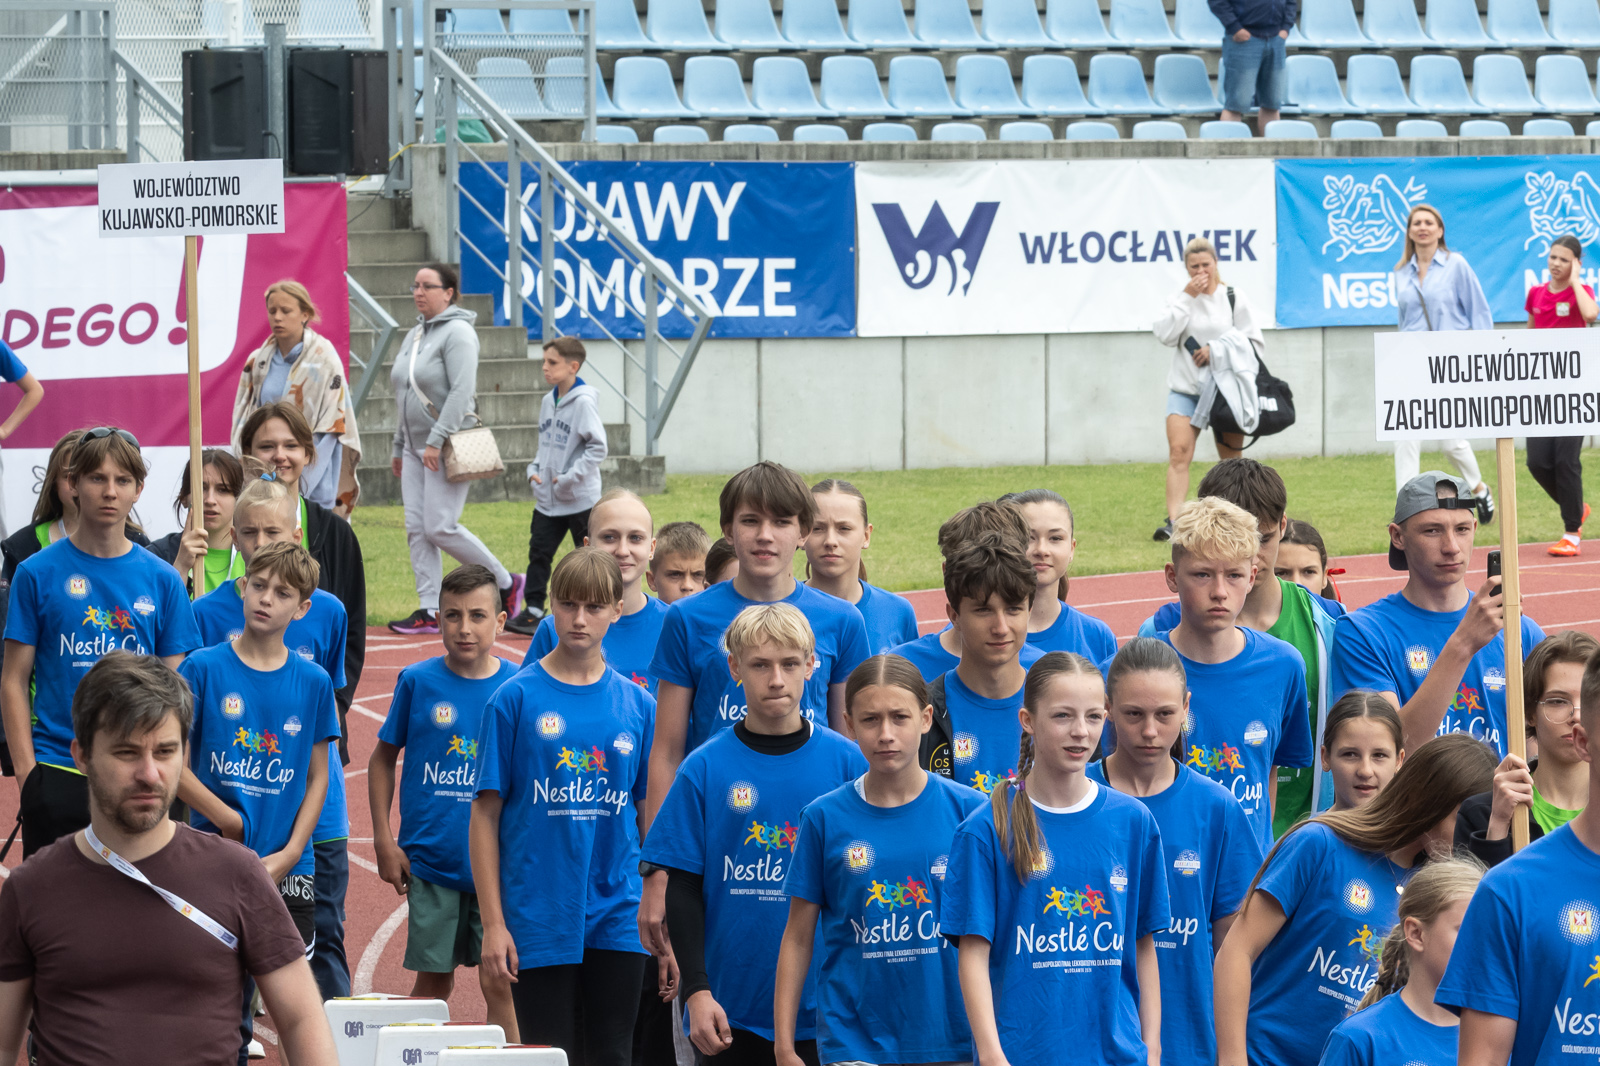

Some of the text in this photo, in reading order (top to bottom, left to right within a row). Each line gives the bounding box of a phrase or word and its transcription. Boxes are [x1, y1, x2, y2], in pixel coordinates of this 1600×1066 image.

[133, 173, 241, 199] WOJEWÓDZTWO
[102, 204, 279, 231] KUJAWSKO-POMORSKIE
[504, 181, 747, 243] KUJAWY
[503, 257, 797, 320] POMORZE
[1322, 272, 1399, 309] Nest
[1428, 348, 1582, 385] WOJEWÓDZTWO
[60, 633, 145, 656] Nestlé Cu
[1468, 716, 1502, 753] Cup
[211, 752, 260, 779] Nestlé
[266, 757, 294, 793] Cup
[423, 762, 475, 786] Nestlé
[533, 777, 628, 815] Nestlé Cup
[1231, 774, 1263, 810] Cup
[723, 854, 784, 882] Nestlé
[850, 912, 913, 945] Nestlé
[1015, 921, 1124, 955] Nestlé Cu
[1308, 946, 1378, 995] Nestlé
